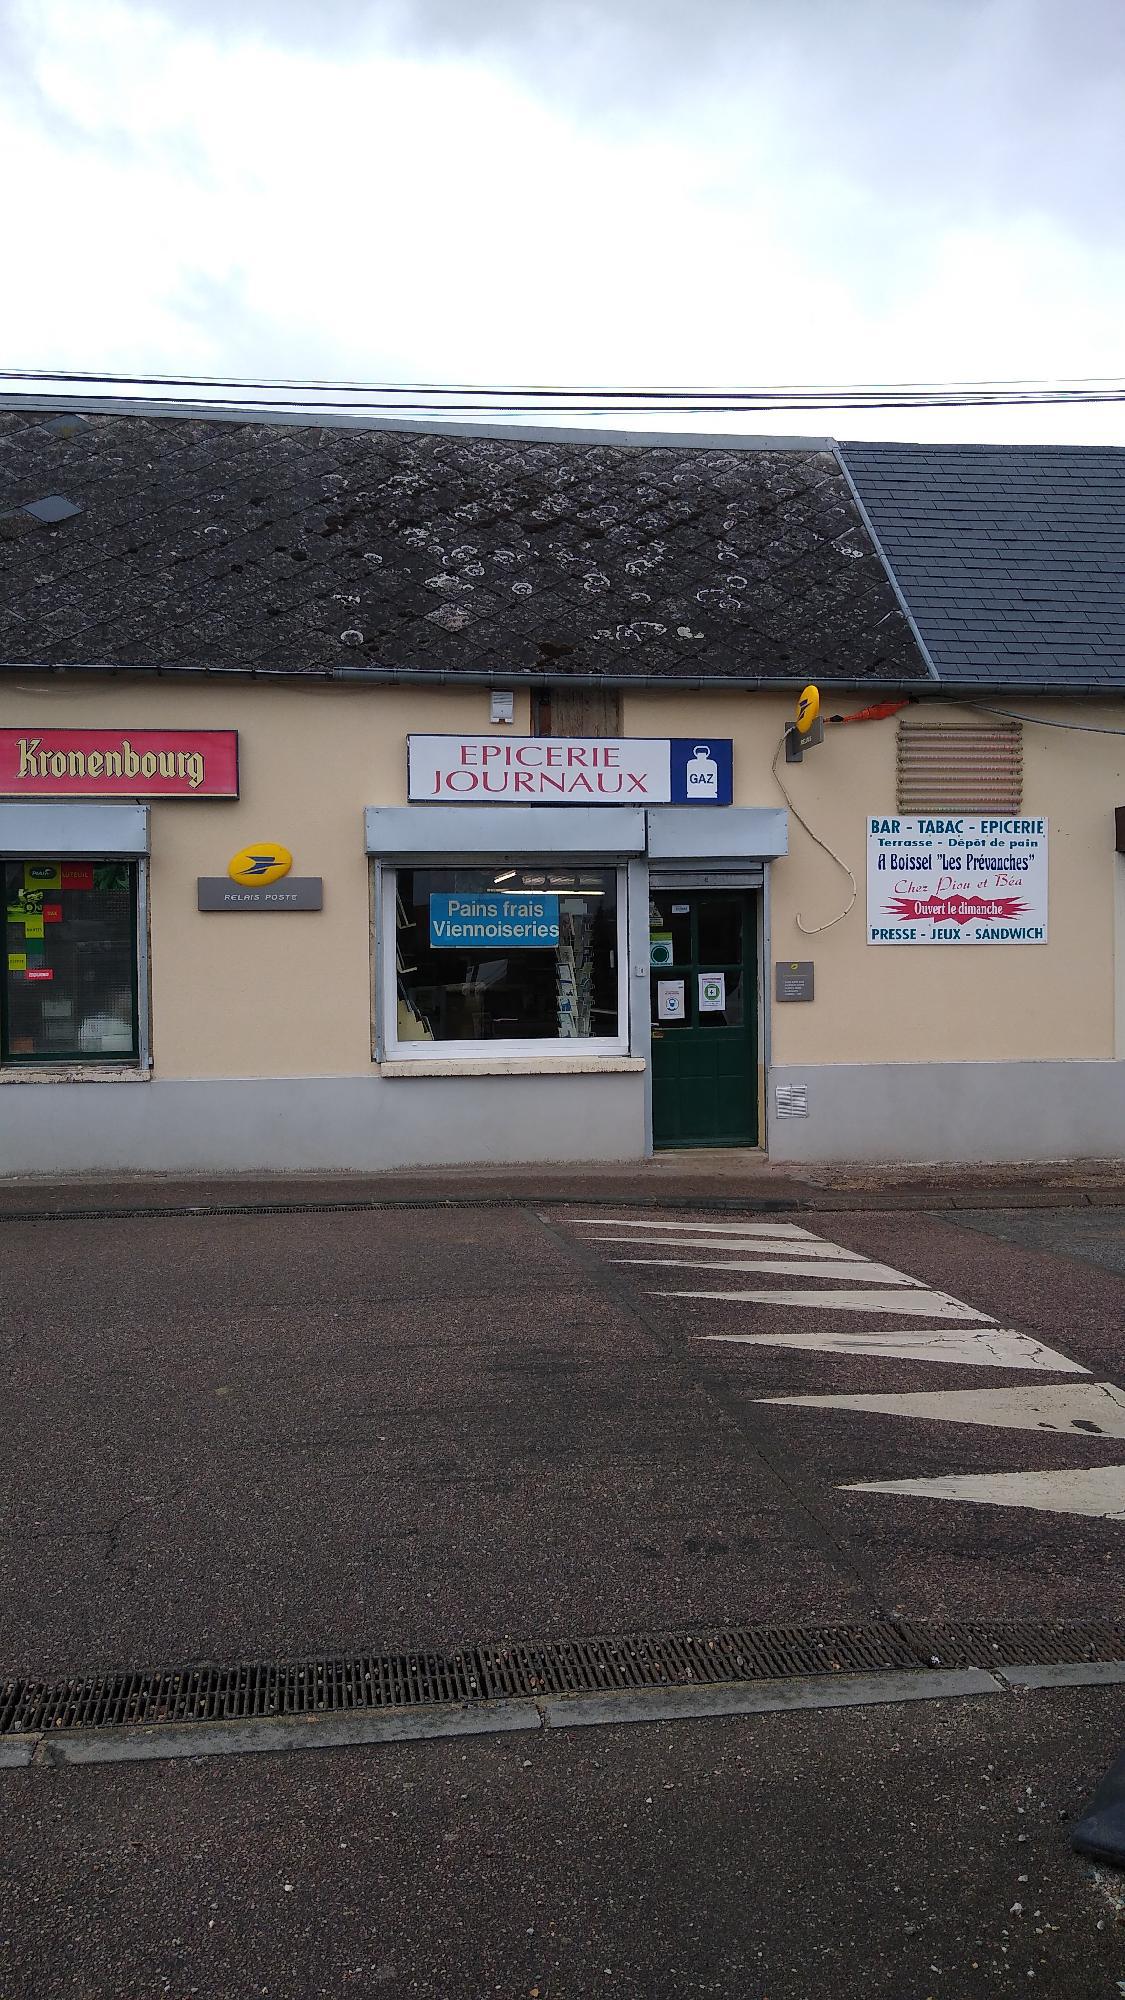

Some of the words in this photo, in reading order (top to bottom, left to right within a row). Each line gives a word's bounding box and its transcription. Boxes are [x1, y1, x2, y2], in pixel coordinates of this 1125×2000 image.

[16, 738, 205, 789] Kronenbourg
[460, 745, 620, 768] EPICERIE
[431, 770, 648, 795] JOURNAUX
[689, 773, 714, 785] GAZ
[871, 820, 900, 834] BAR
[917, 820, 964, 834] TABAC
[980, 820, 1044, 834] EPICERIE
[878, 838, 933, 847] Terrasse
[948, 838, 986, 849] Dépôt
[990, 838, 1005, 847] de
[1009, 838, 1038, 849] pain
[877, 853, 886, 870] A
[890, 853, 932, 870] Boissel
[894, 879, 928, 894] Chez
[935, 876, 970, 895] Piou
[977, 878, 988, 888] et
[994, 873, 1022, 887] Béa
[448, 900, 498, 917] Pains
[502, 900, 544, 917] frais
[914, 902, 945, 915] Ouvert
[948, 902, 957, 915] le
[958, 901, 1003, 915] dimanche
[432, 920, 560, 938] Viennoiseries
[871, 928, 917, 940] PRESSE
[930, 928, 961, 940] JEUX
[975, 927, 1043, 940] SANDWICH
